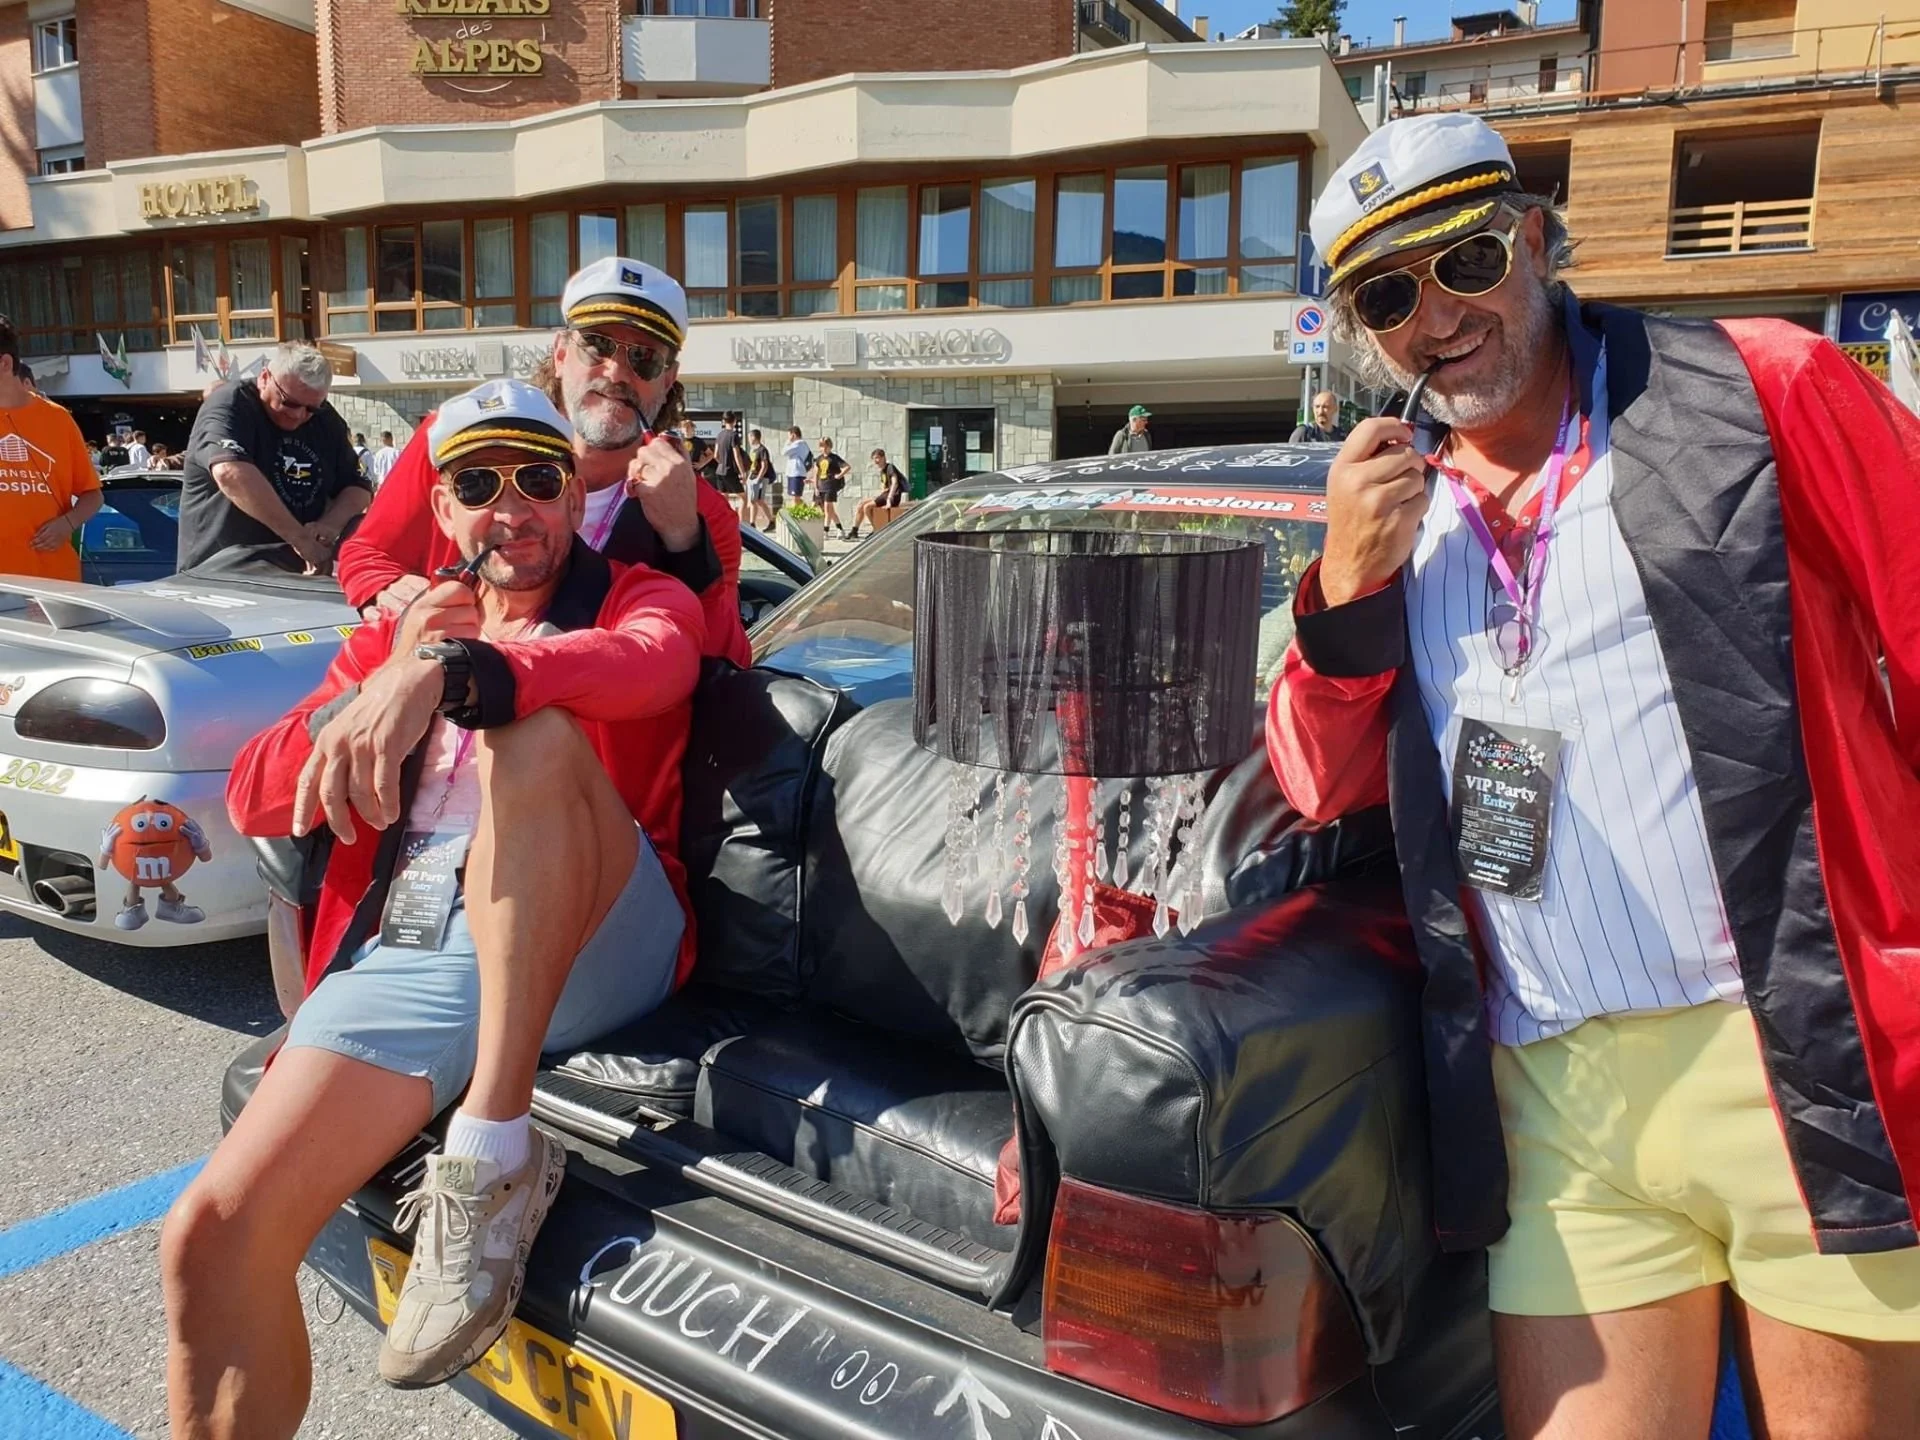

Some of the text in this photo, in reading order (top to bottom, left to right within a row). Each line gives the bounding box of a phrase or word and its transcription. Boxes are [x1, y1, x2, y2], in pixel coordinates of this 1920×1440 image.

[455, 20, 493, 39] des
[410, 39, 543, 73] ALPES
[137, 175, 258, 217] HOTEL
[1362, 185, 1395, 213] CAPTAIN
[731, 328, 1003, 362] INTESA SANPAOLO
[1131, 493, 1295, 512] Barcelona
[189, 632, 313, 659] Barmy to
[0, 759, 74, 795] 2022
[1465, 775, 1538, 802] VIP Party
[1483, 794, 1518, 812] Entry
[401, 870, 448, 883] VIP Party
[411, 882, 433, 892] Entry
[578, 1235, 812, 1373] COUCH
[525, 1338, 632, 1440] CFV
